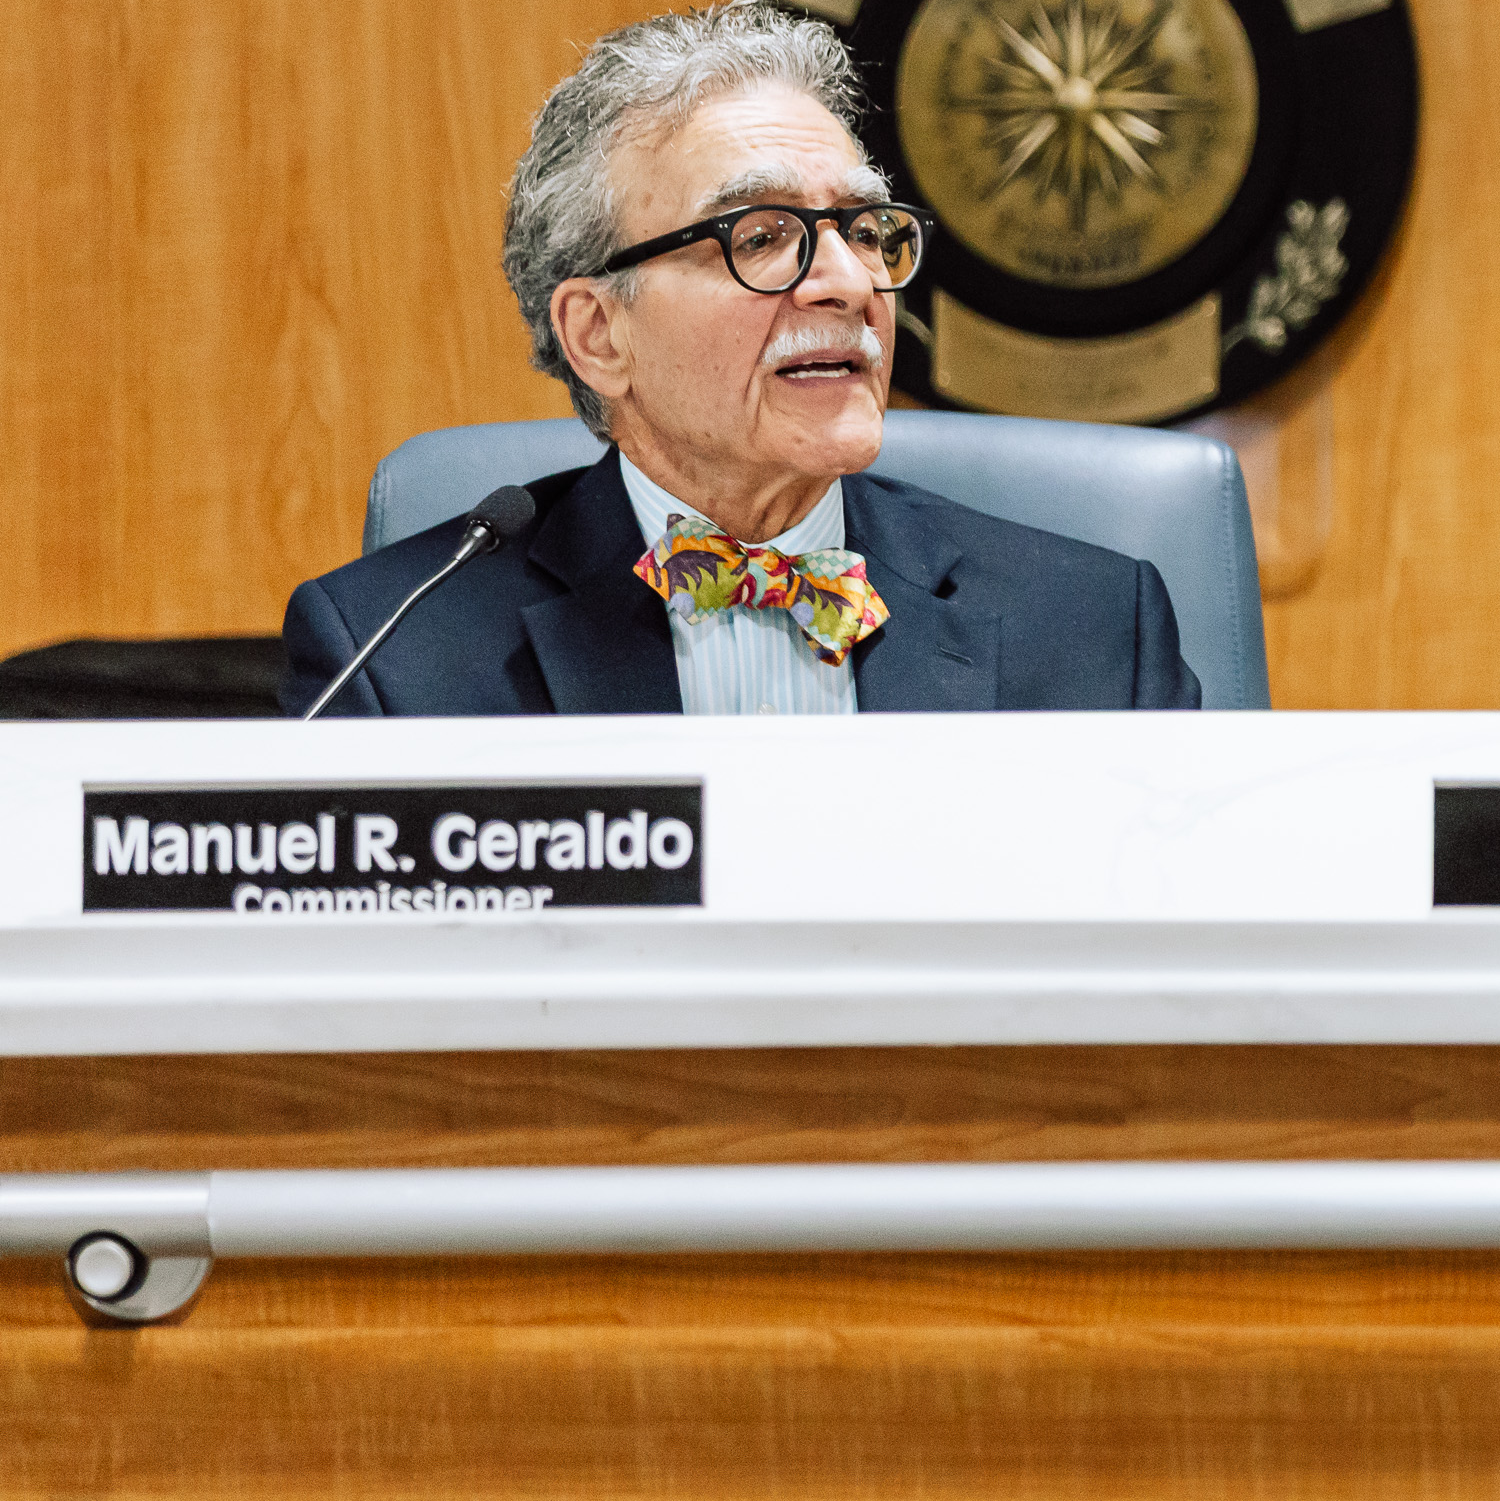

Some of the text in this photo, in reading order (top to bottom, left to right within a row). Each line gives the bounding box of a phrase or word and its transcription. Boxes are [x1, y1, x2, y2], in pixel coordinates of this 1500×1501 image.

[92, 811, 694, 875] Manuel R. Geraldo
[232, 880, 553, 912] Commissioner
